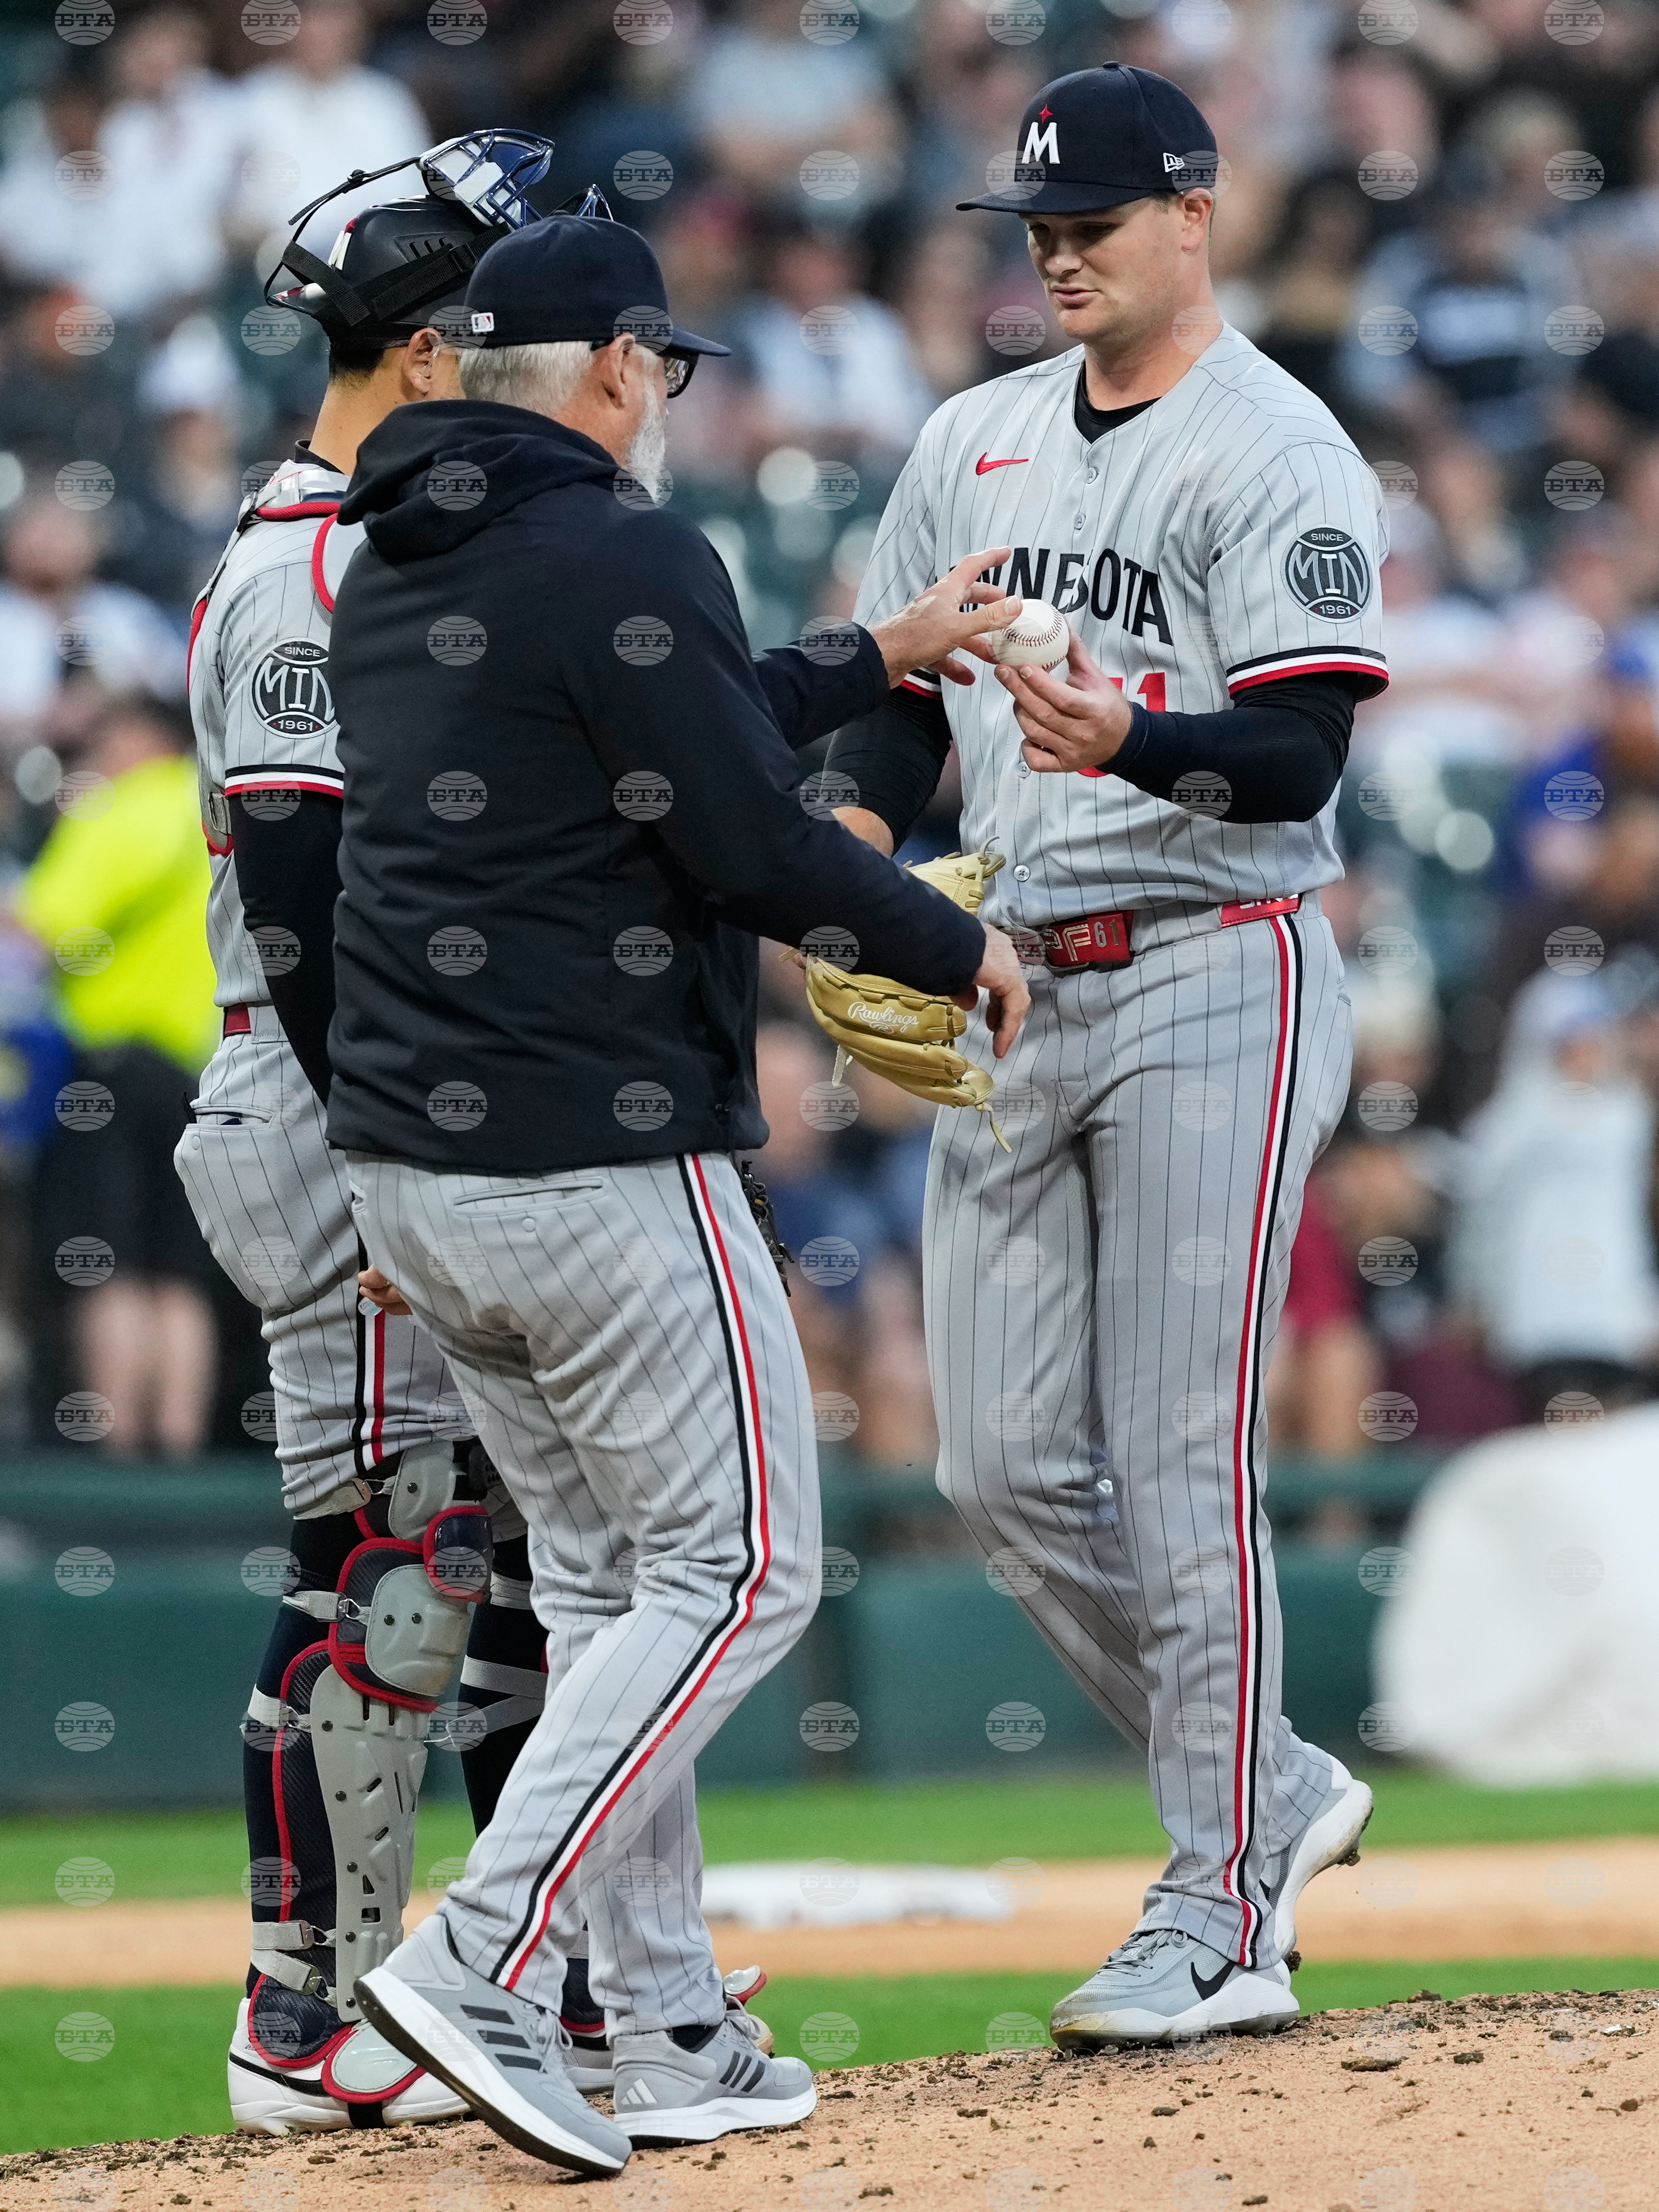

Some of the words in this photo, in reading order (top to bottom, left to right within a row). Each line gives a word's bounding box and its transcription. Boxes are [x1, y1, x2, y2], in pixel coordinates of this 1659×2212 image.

[1021, 122, 1060, 164] M
[1310, 533, 1344, 541] SINCE
[1288, 543, 1368, 605] MIN
[1320, 604, 1351, 615] 1961
[284, 647, 321, 657] SINCE
[278, 719, 313, 731] 1961
[1094, 919, 1120, 948] 61
[848, 1002, 919, 1033] Rawlings
